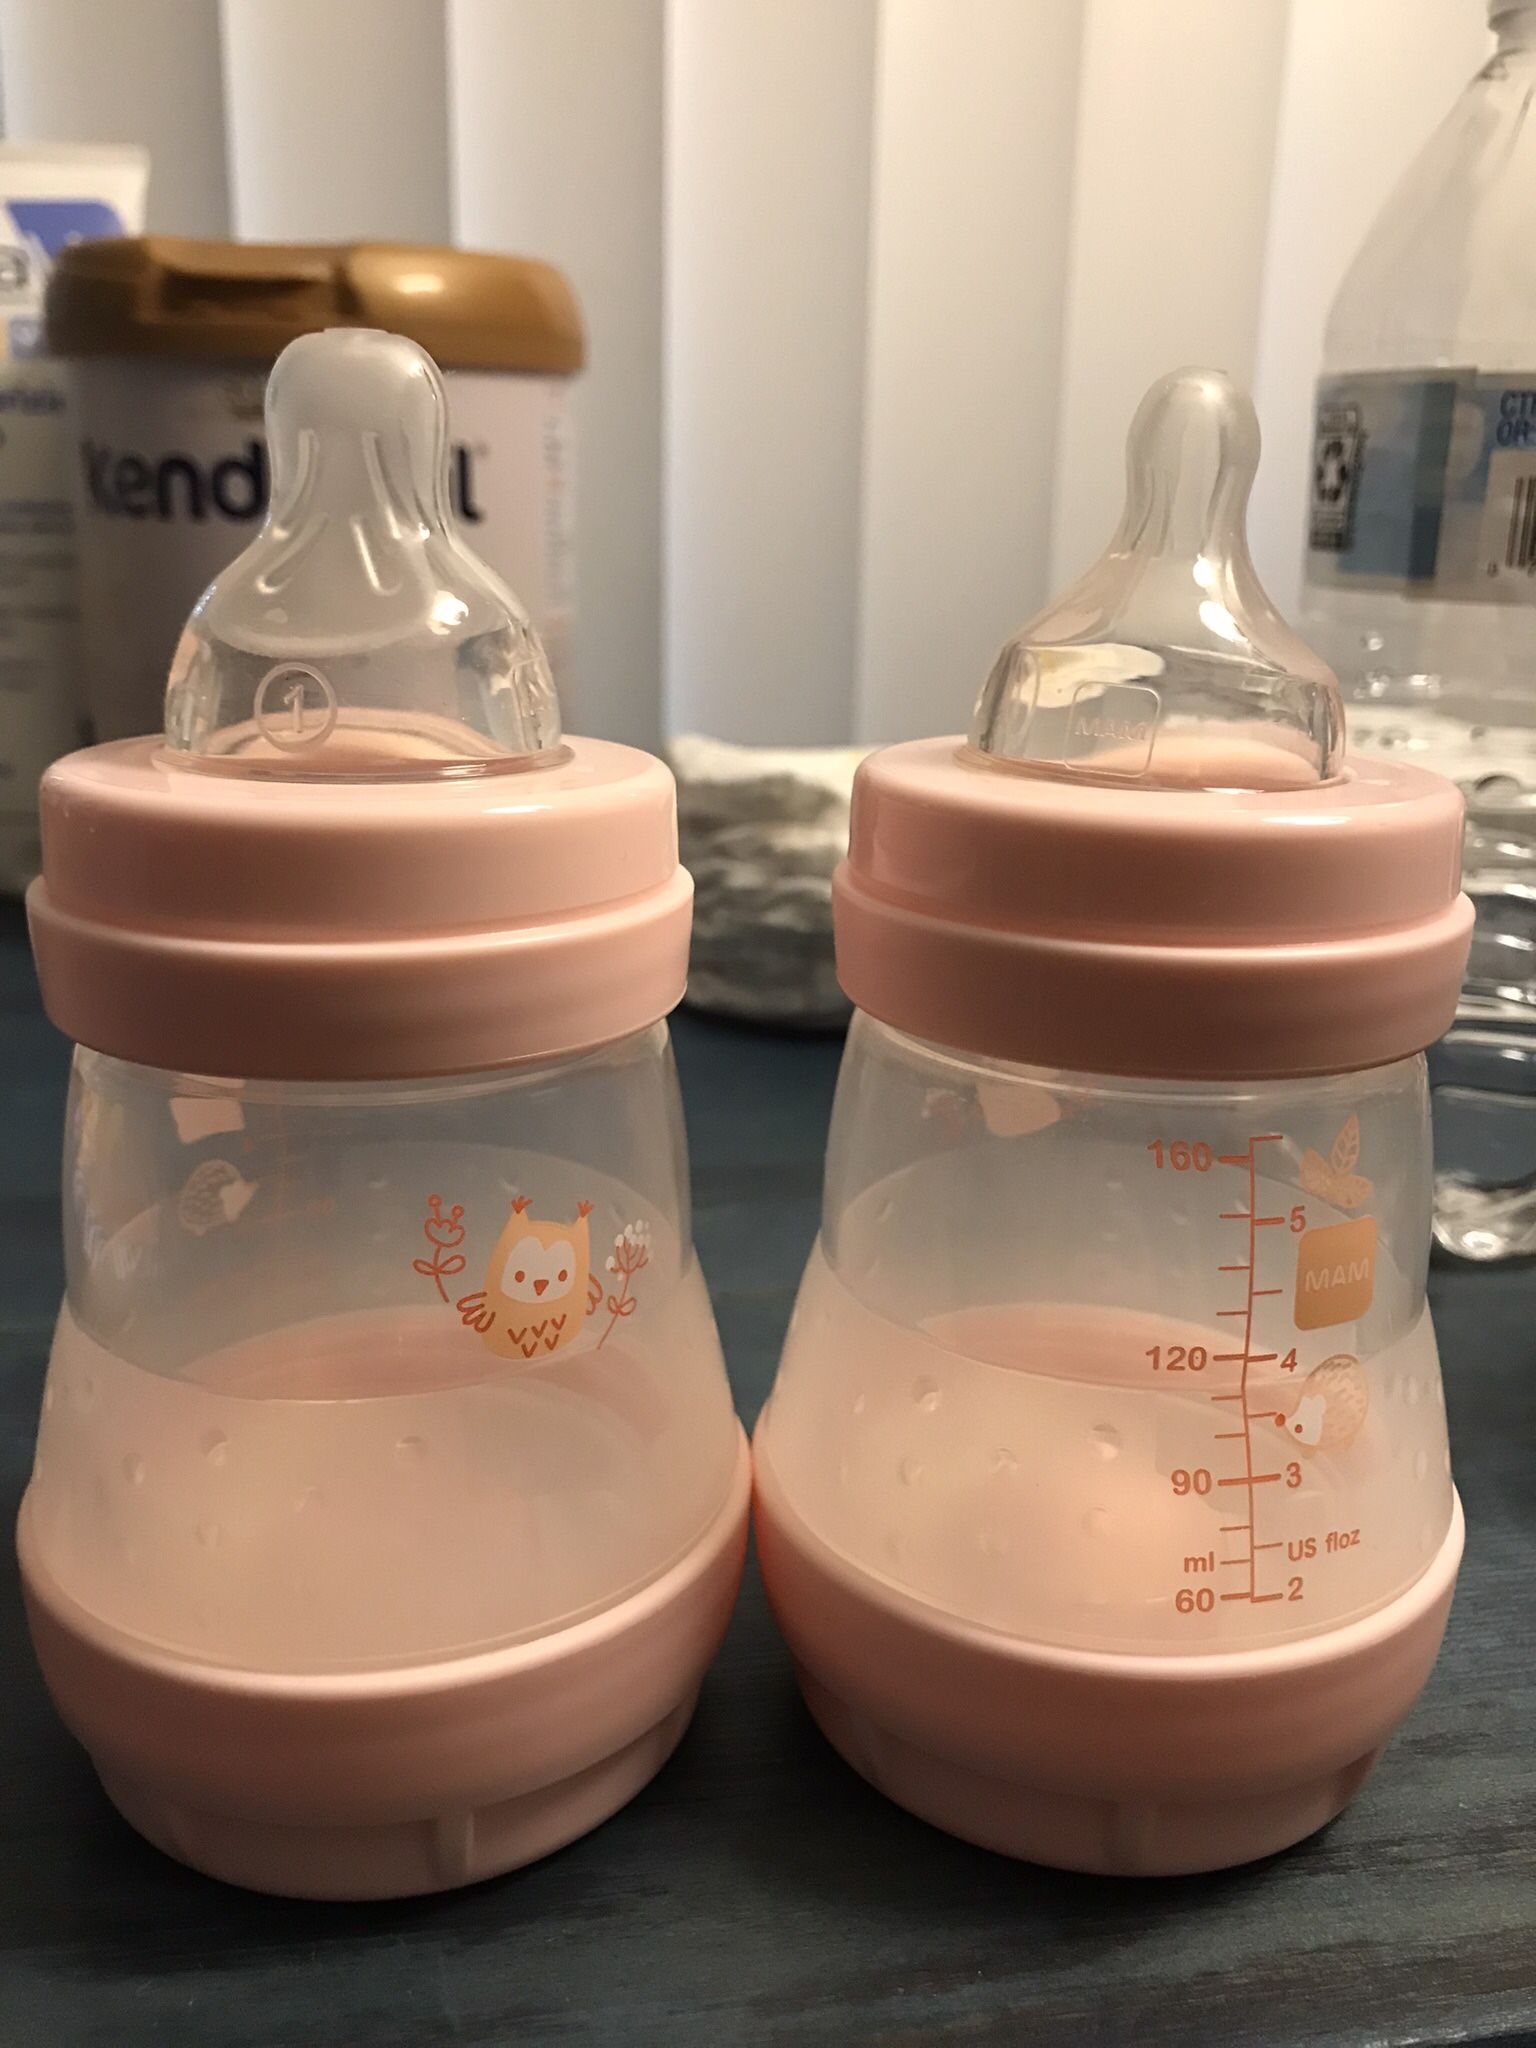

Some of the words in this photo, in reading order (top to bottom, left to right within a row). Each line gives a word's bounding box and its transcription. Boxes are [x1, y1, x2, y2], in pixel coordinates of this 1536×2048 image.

[1147, 1139, 1213, 1172] 160
[1290, 1205, 1307, 1234] 5
[1304, 1257, 1370, 1293] MAM
[1145, 1346, 1208, 1372] 120
[1280, 1347, 1298, 1373] 4
[1171, 1468, 1212, 1496] 90
[1286, 1461, 1302, 1489] 3
[1183, 1551, 1216, 1573] ml
[1288, 1537, 1317, 1562] US
[1175, 1587, 1216, 1613] 60
[1288, 1576, 1304, 1602] 2
